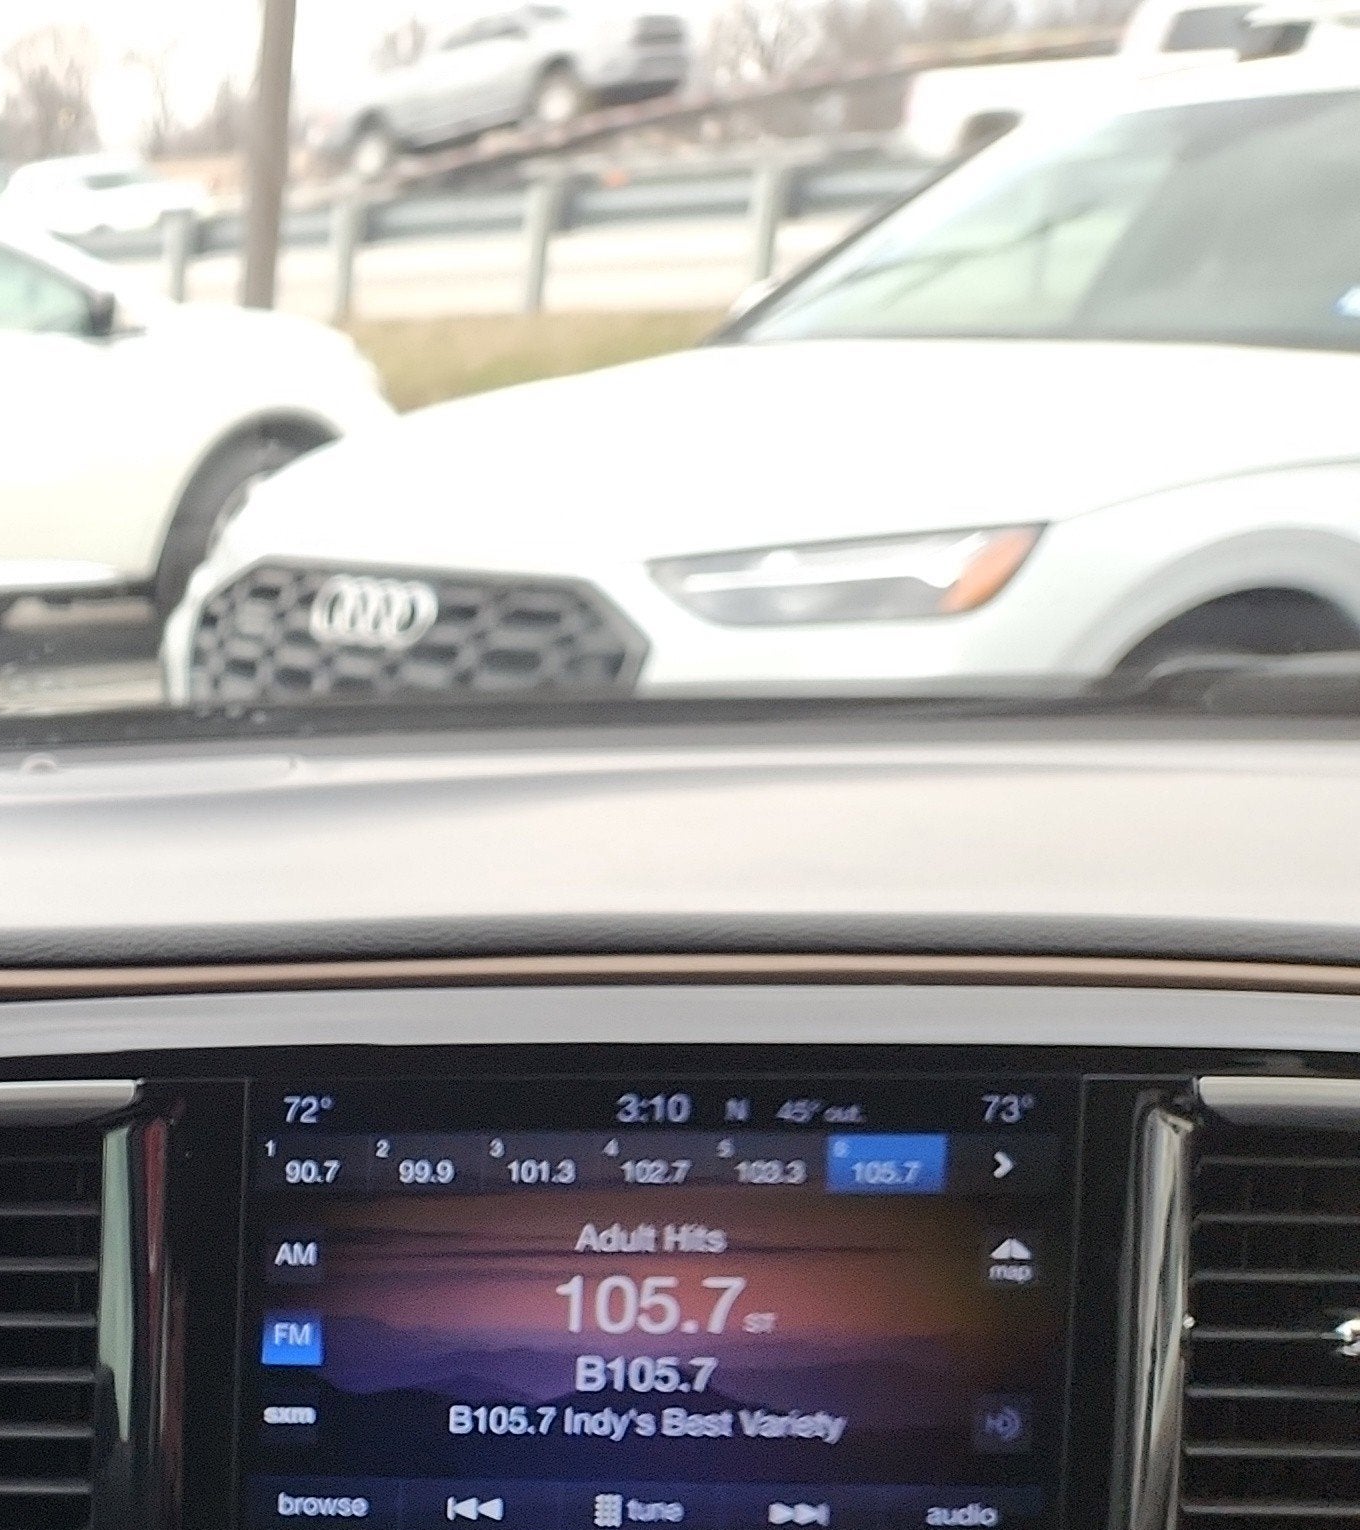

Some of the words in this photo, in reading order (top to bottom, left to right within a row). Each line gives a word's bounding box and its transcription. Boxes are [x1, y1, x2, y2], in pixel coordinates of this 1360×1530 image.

[617, 1093, 691, 1123] 3:10
[265, 1139, 276, 1158] 1
[376, 1140, 390, 1159] 2
[489, 1138, 505, 1159] 3
[603, 1138, 620, 1157] 4
[284, 1160, 341, 1185] 90.7
[398, 1159, 456, 1185] 99.9
[507, 1159, 578, 1185] 101.3
[620, 1159, 693, 1185] 102.7
[575, 1222, 658, 1253] Adult
[664, 1223, 729, 1254] Hits
[274, 1242, 318, 1267] AM
[989, 1265, 1033, 1283] map
[556, 1276, 747, 1335] 105.7
[273, 1323, 312, 1346] FM
[575, 1355, 719, 1393] B105.7
[448, 1405, 557, 1436] B105.7
[563, 1407, 656, 1442] Indy's
[662, 1408, 734, 1438] Best
[740, 1410, 848, 1445] Variety
[278, 1493, 369, 1517] browse
[626, 1498, 685, 1523] tune
[925, 1503, 999, 1527] audio
